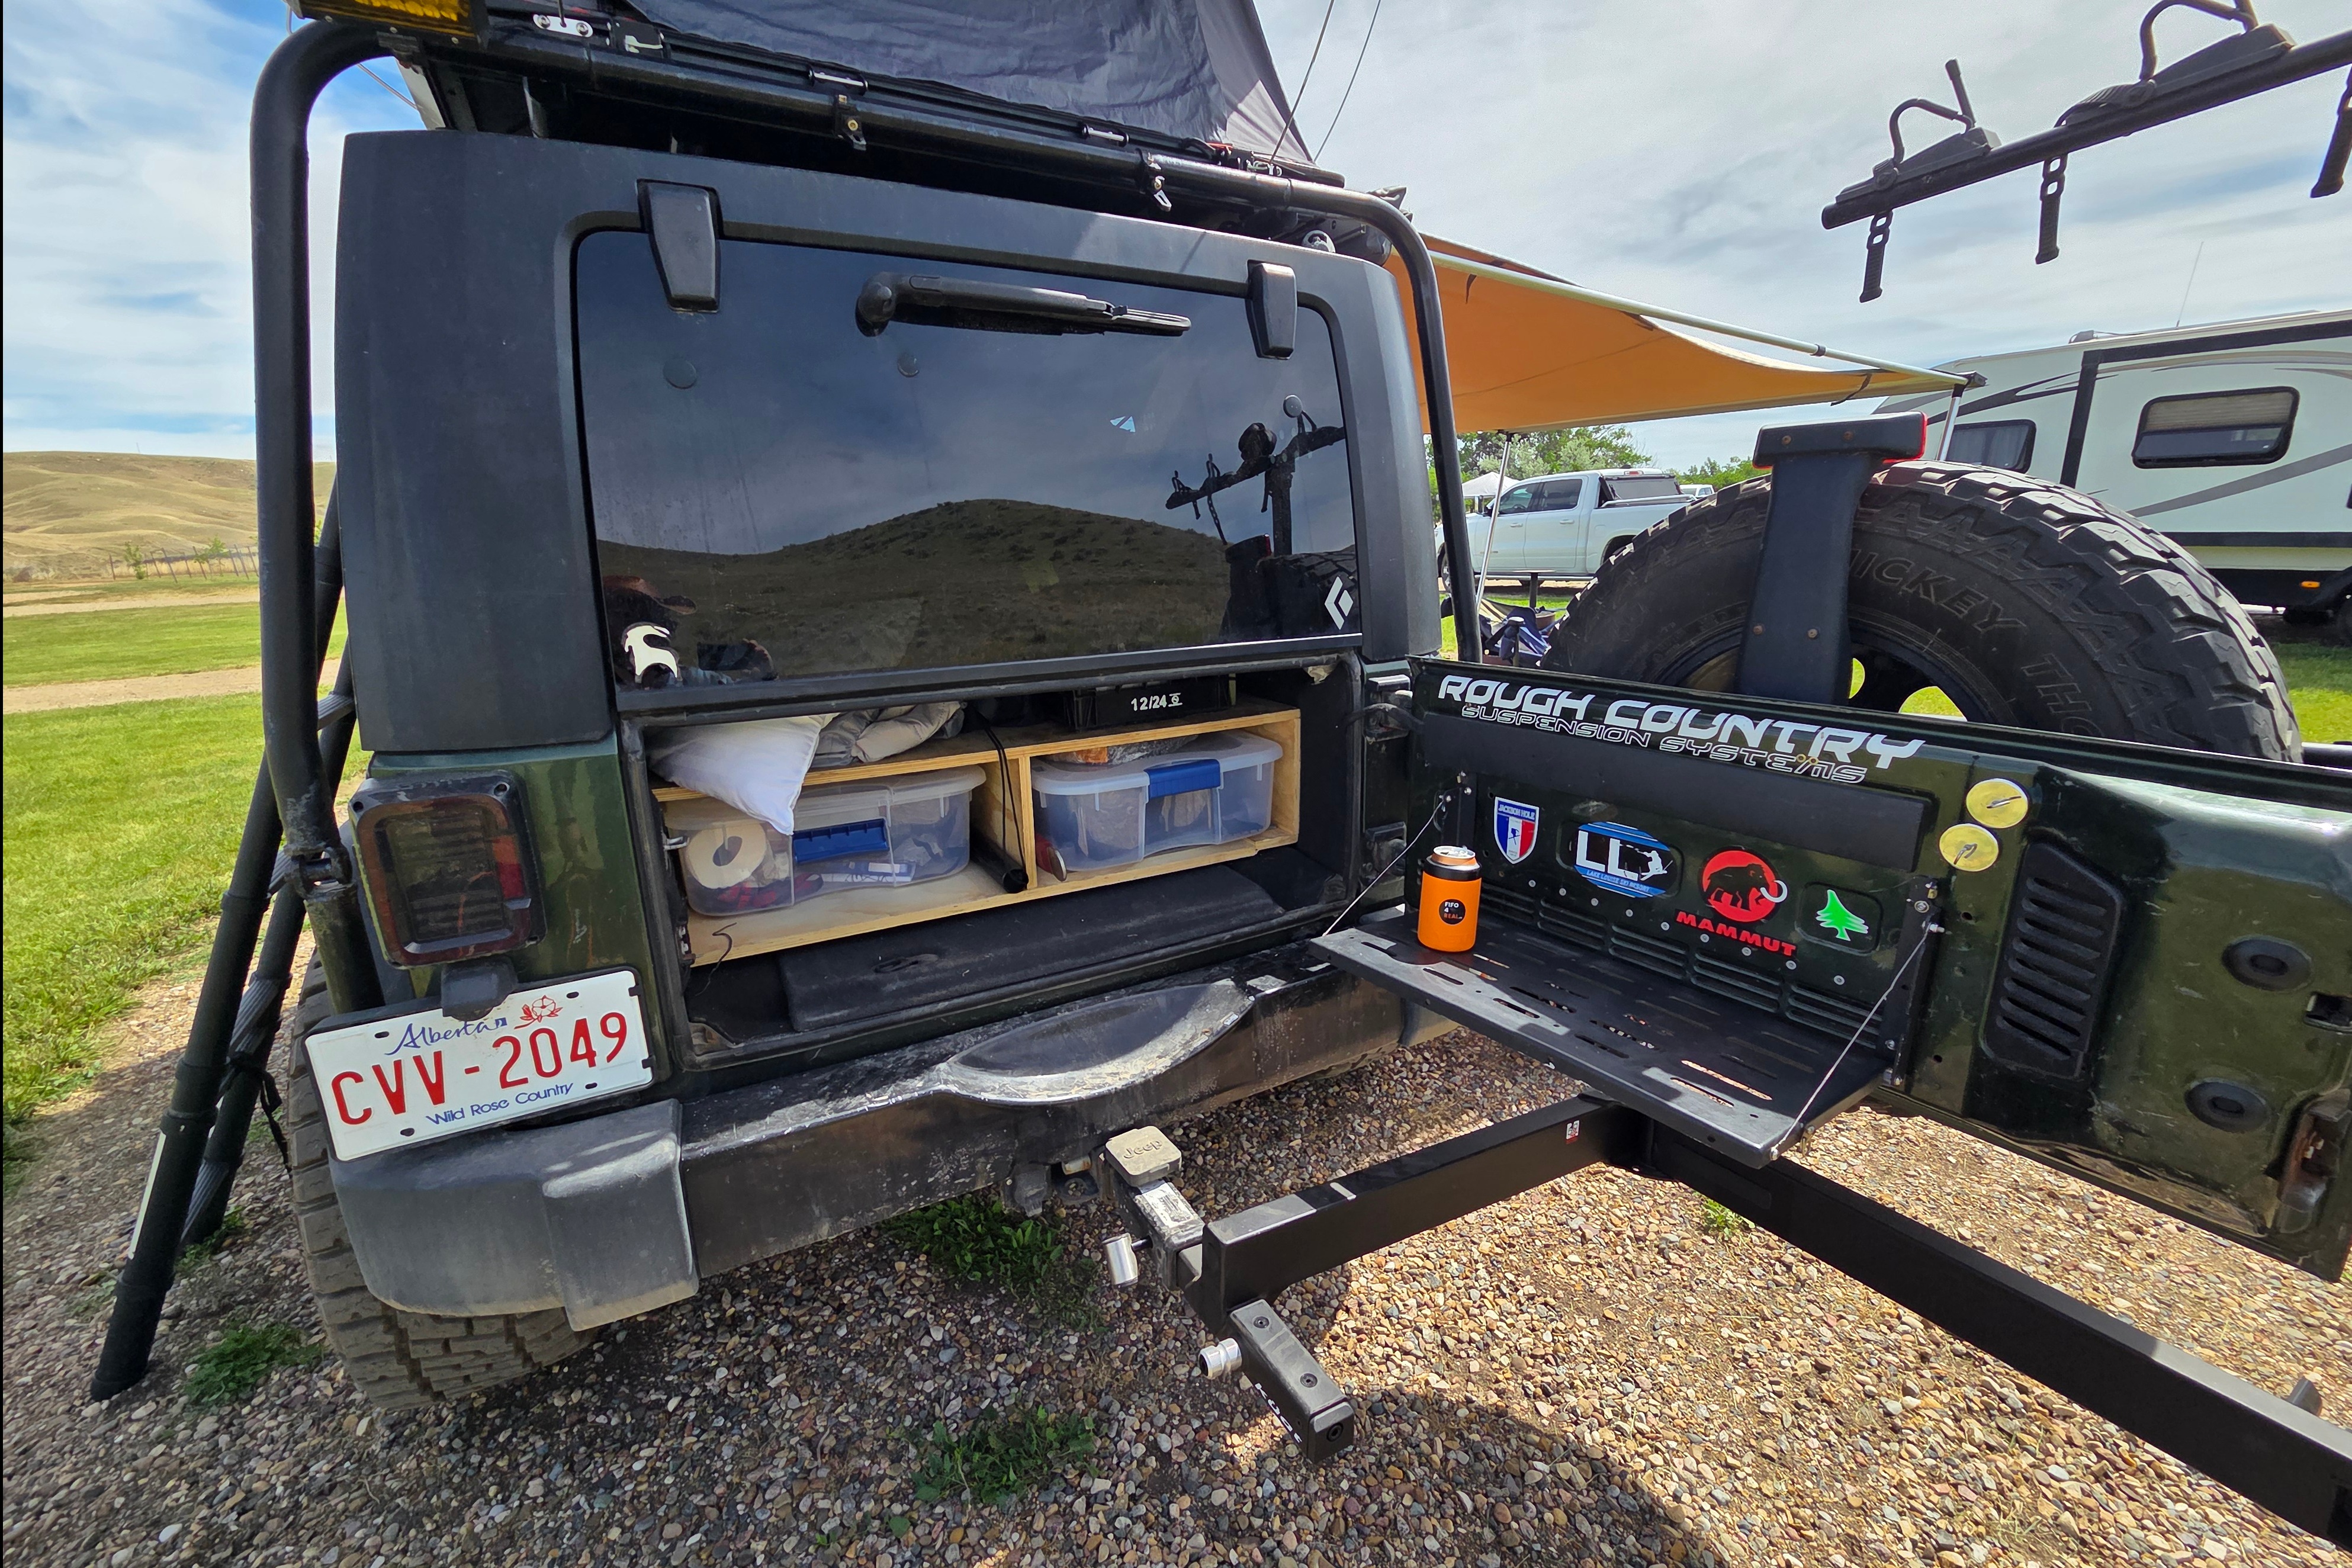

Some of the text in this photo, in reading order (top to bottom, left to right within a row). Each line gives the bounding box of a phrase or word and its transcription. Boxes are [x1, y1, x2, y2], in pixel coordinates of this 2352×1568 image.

[1849, 548, 2028, 636] ICKEY
[1438, 674, 1926, 769] ROUGH COUNTRY
[1461, 705, 1868, 783] SUSPENSION SYSTEMS
[1676, 911, 1797, 956] MAMMUT
[384, 1019, 490, 1056] Alberta
[330, 1012, 628, 1126] CVV-2049
[426, 1082, 574, 1125] Wild Rose Country
[1123, 1140, 1162, 1159] Jeep
